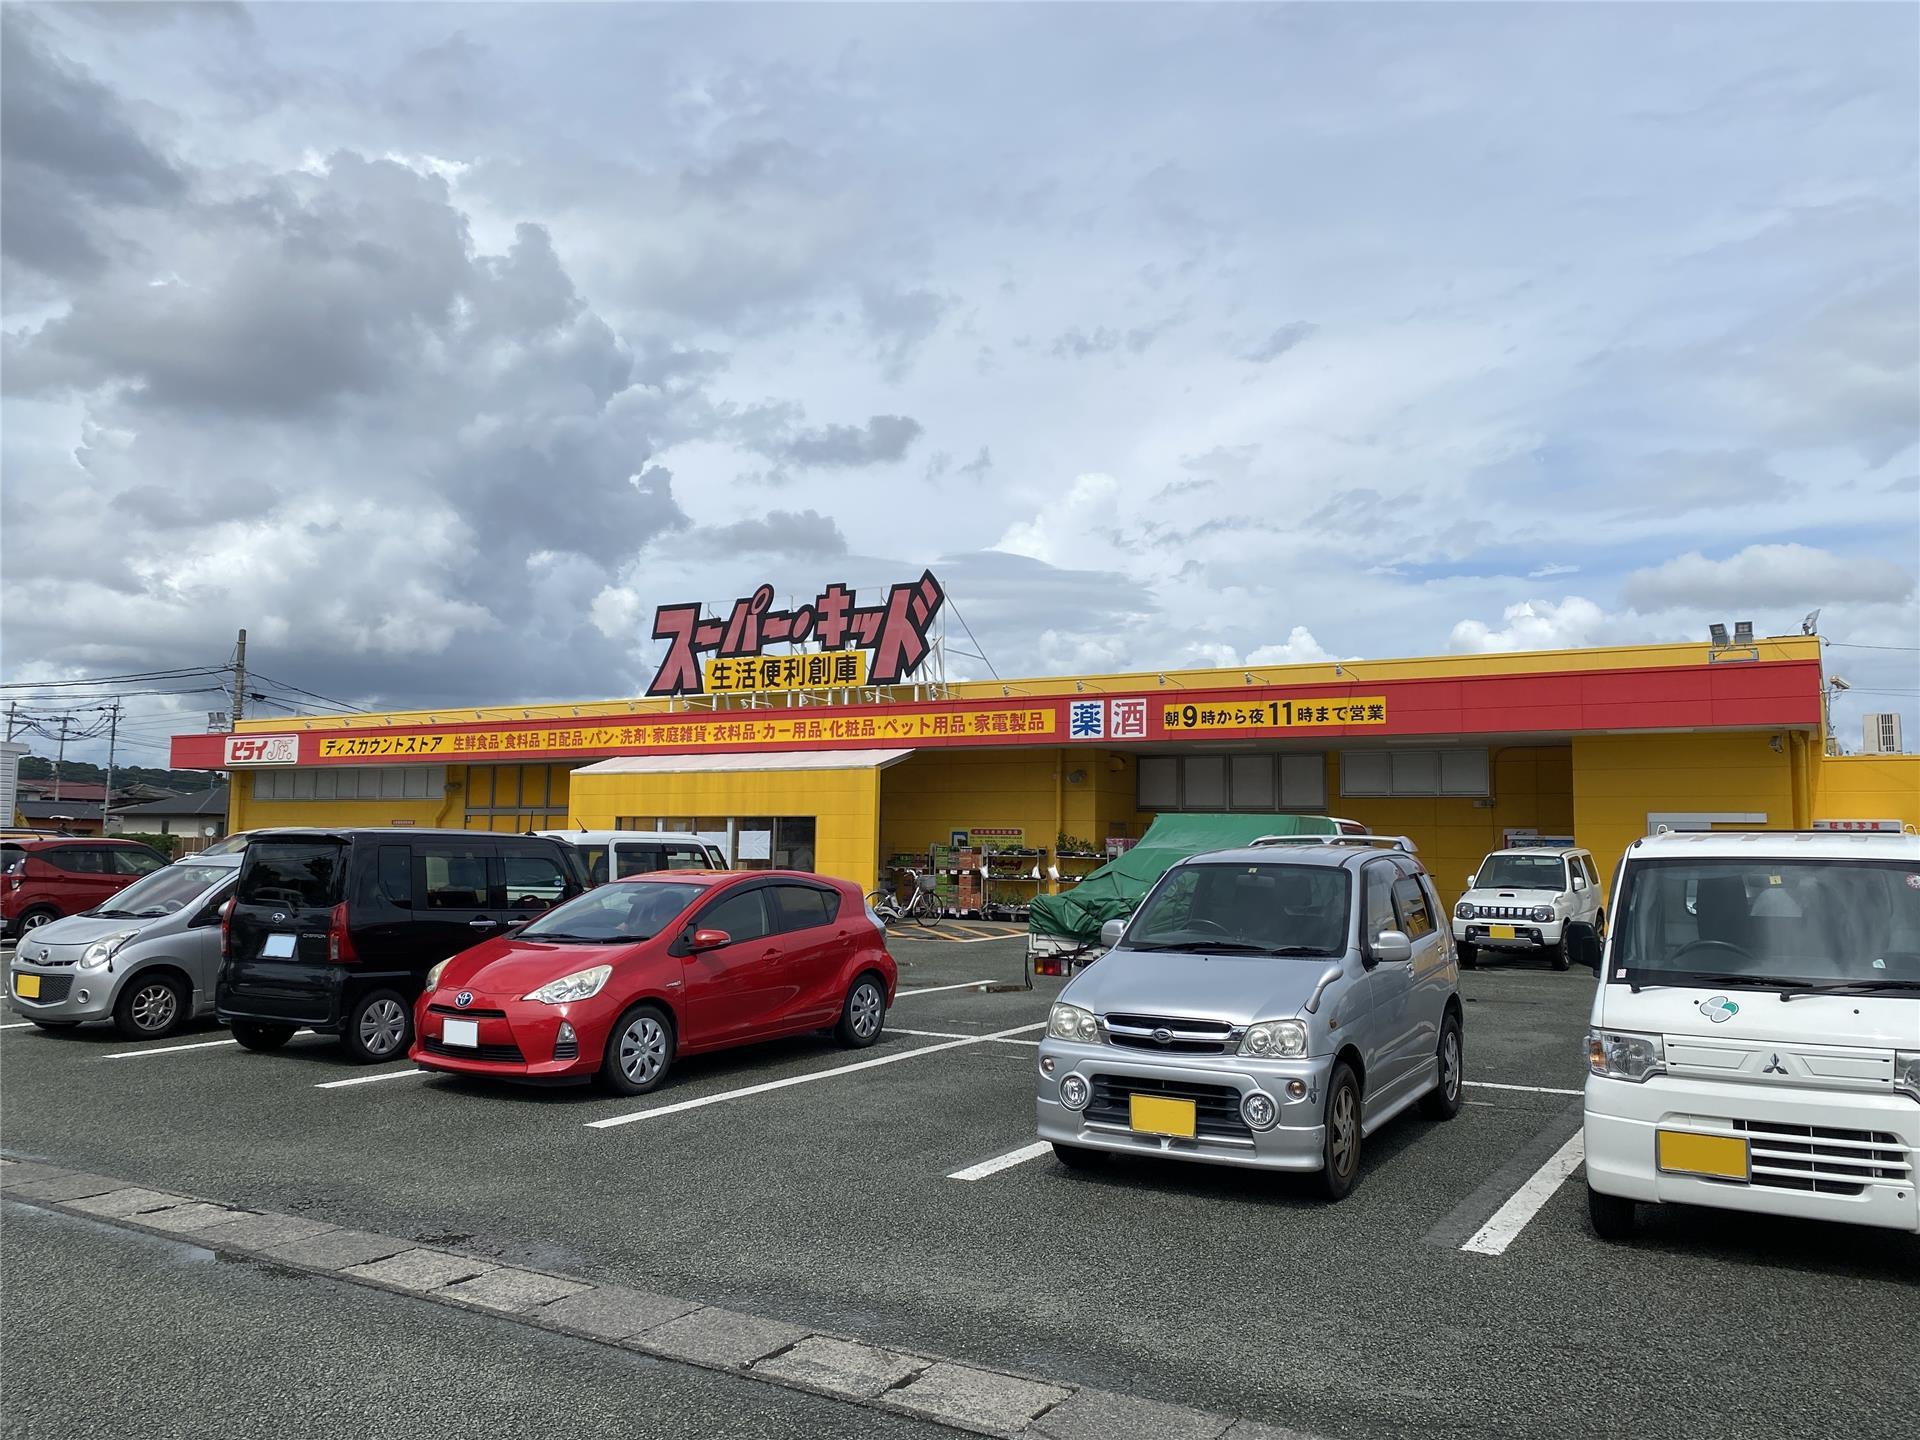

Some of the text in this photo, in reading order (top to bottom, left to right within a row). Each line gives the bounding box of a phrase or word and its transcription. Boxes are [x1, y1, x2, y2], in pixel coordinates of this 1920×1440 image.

[711, 654, 858, 690] 生活便利創庫
[1072, 703, 1102, 736] 薬
[1113, 701, 1145, 735] 酒
[1165, 702, 1385, 728] 朝9時から夜11時まで営業
[231, 740, 268, 760] ヒライ
[325, 736, 443, 755] ディスカウントストア
